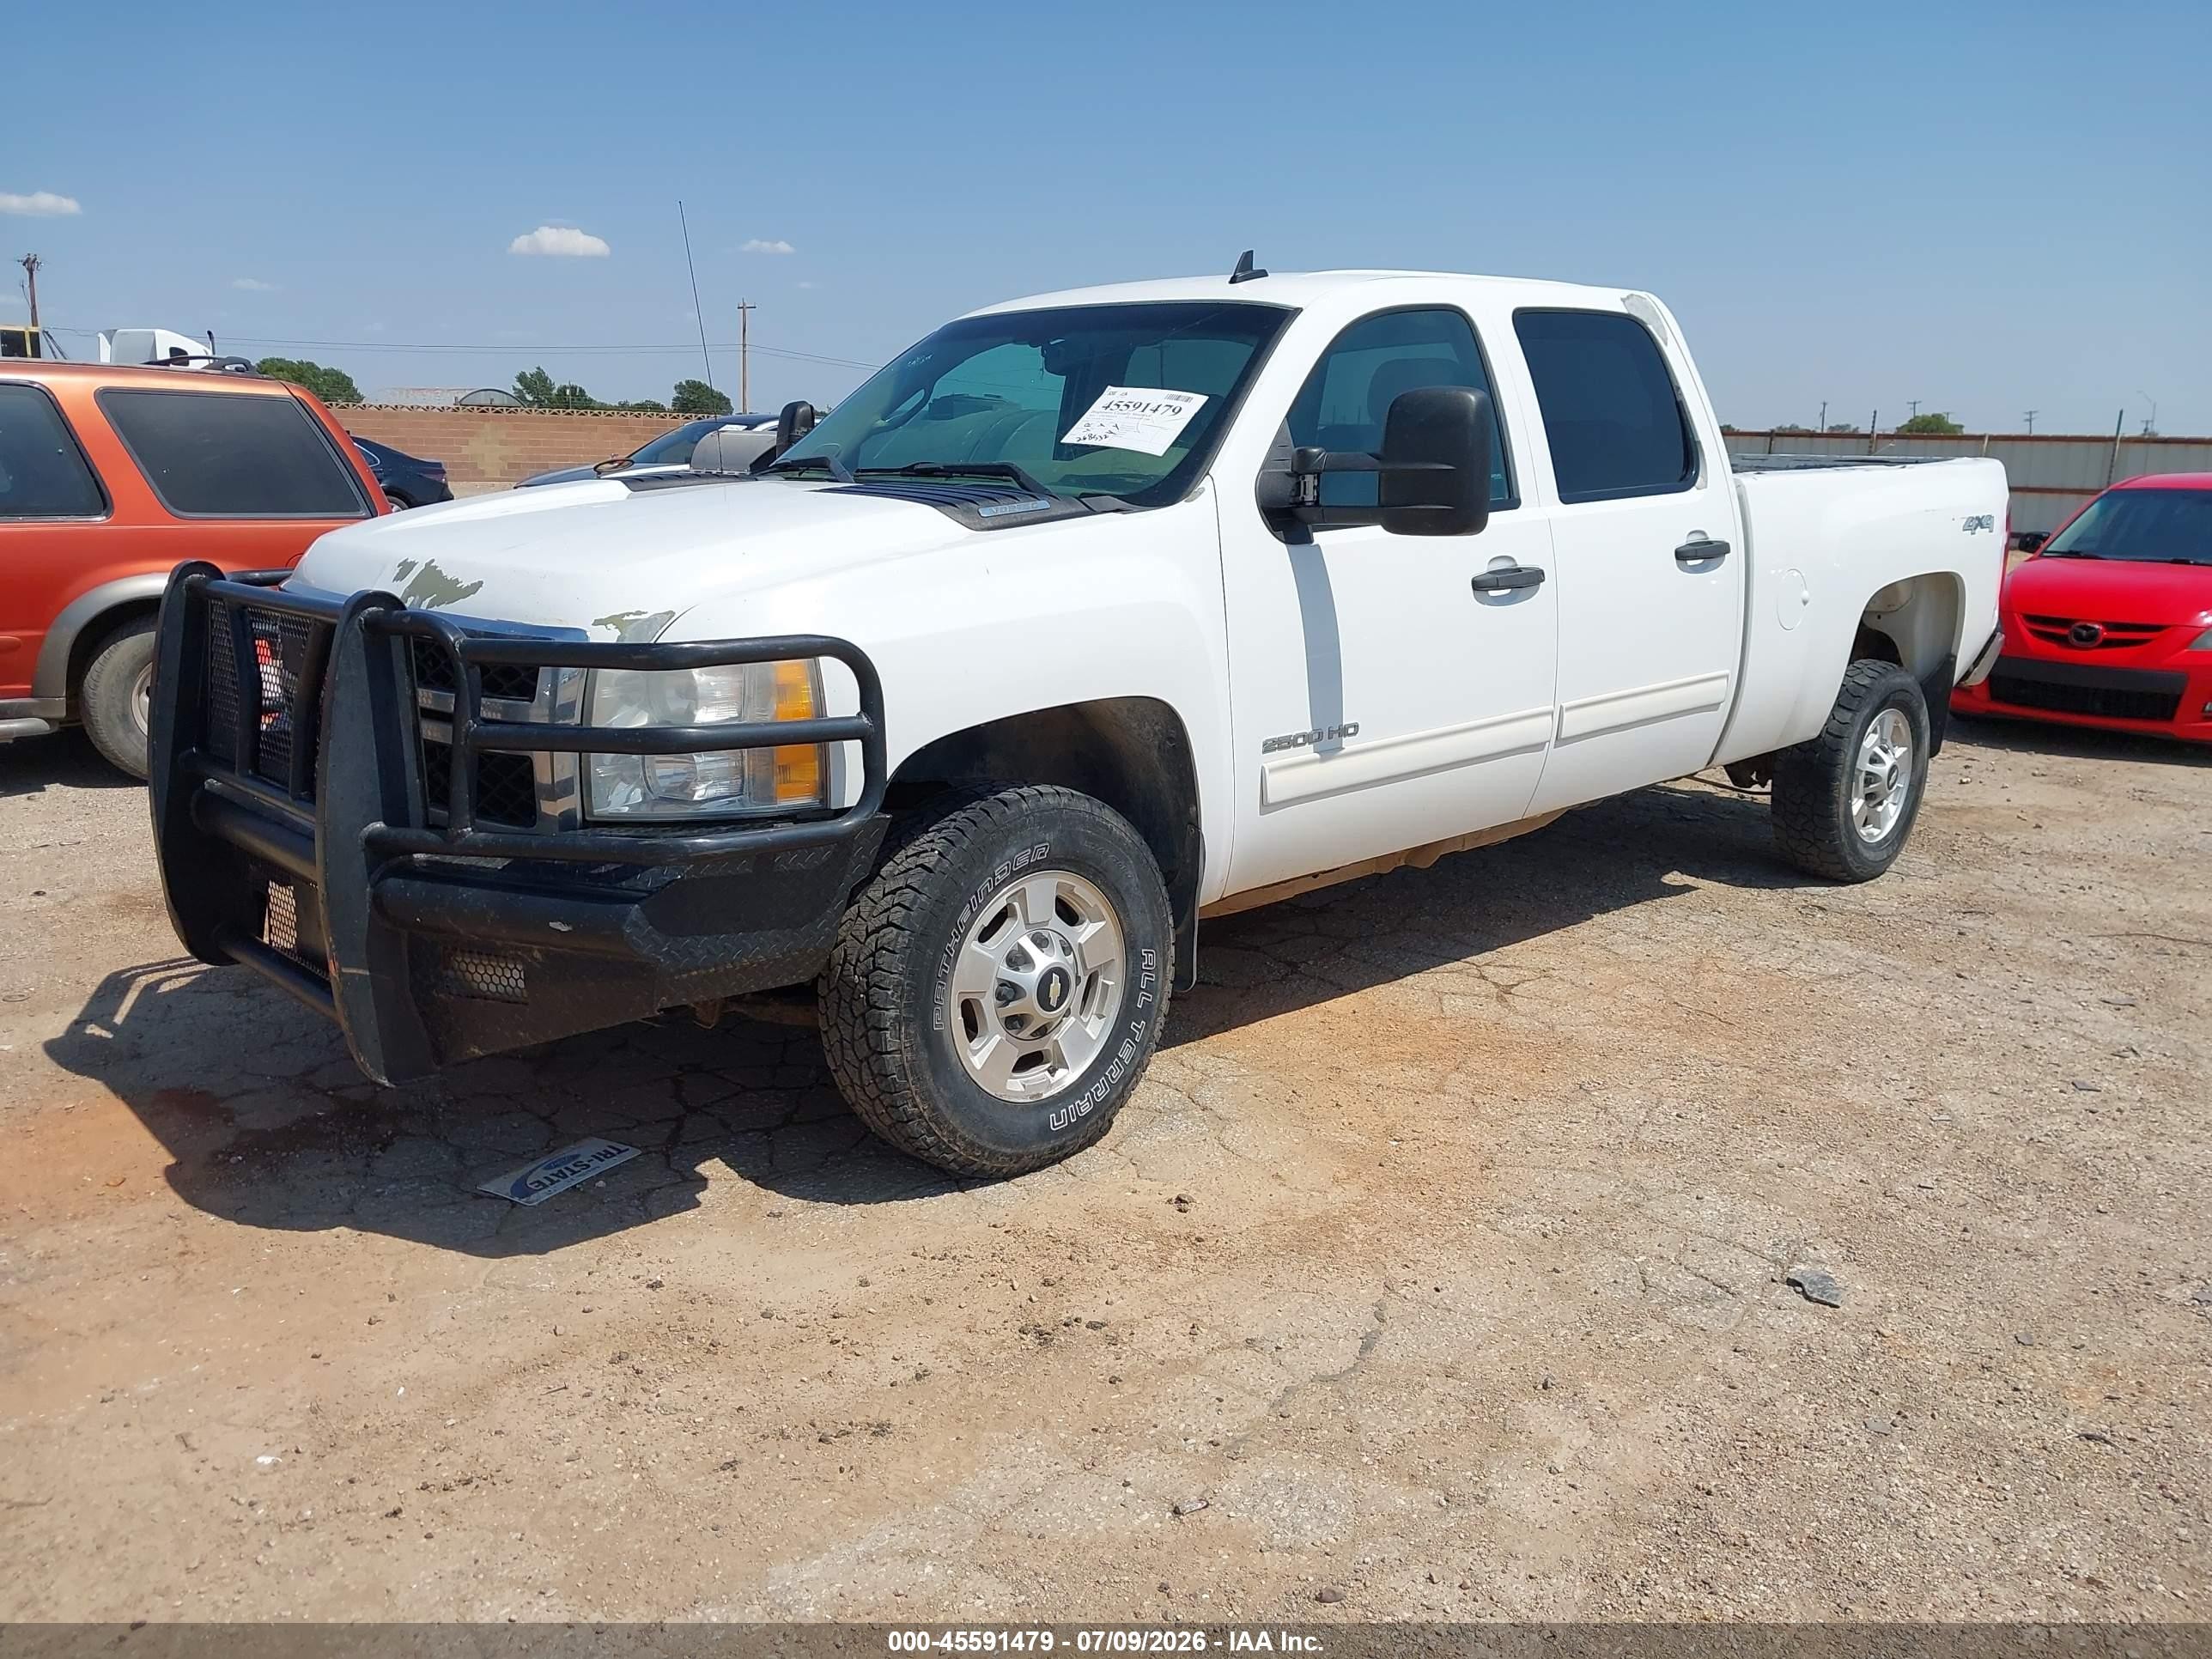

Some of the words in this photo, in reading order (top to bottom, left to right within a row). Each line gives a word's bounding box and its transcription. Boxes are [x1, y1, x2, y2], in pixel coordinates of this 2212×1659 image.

[1102, 400, 1182, 416] 45591479
[1262, 728, 1323, 754] 2500
[1328, 721, 1359, 739] HD
[933, 842, 1050, 1031] PATHFINDER
[1136, 948, 1157, 1010] ALL
[1049, 1019, 1146, 1132] TERRAIN
[528, 1145, 629, 1191] TRI-STATE
